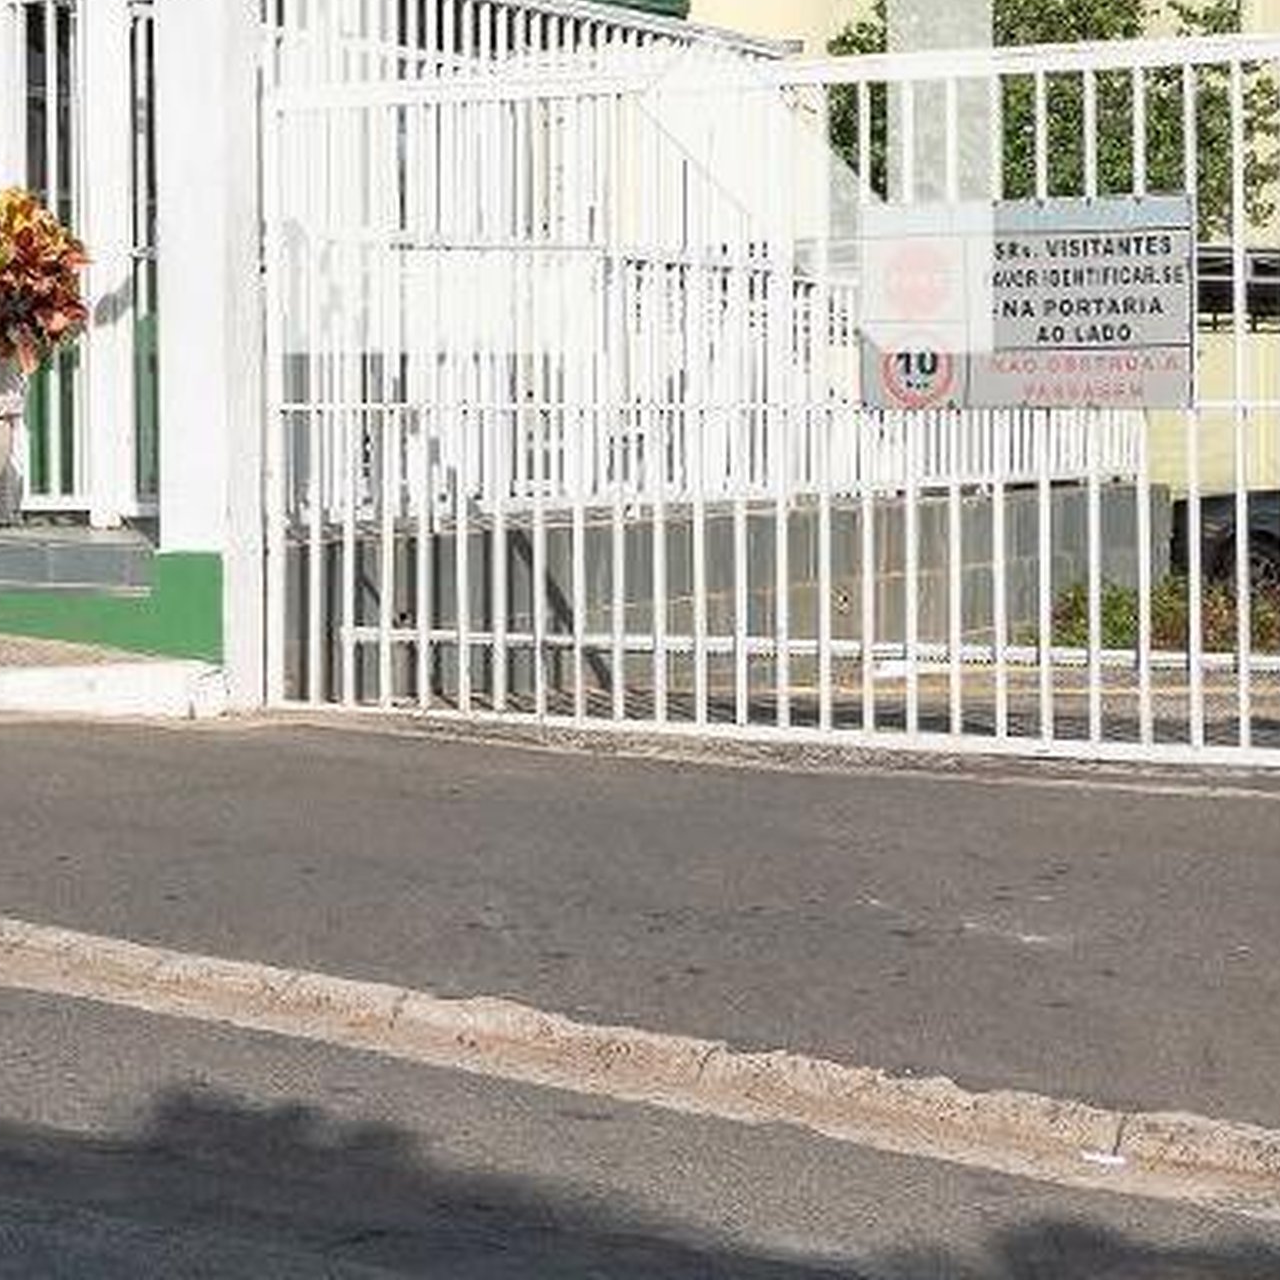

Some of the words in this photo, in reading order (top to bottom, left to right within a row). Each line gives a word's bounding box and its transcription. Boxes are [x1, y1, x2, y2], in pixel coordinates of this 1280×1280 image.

[1046, 236, 1172, 259] VISITANTES
[984, 268, 1038, 288] AVOR
[1003, 299, 1035, 318] NA
[1043, 296, 1164, 317] PORTARIA
[1037, 325, 1065, 343] AO
[1074, 322, 1132, 342] LADO
[896, 351, 938, 375] 10
